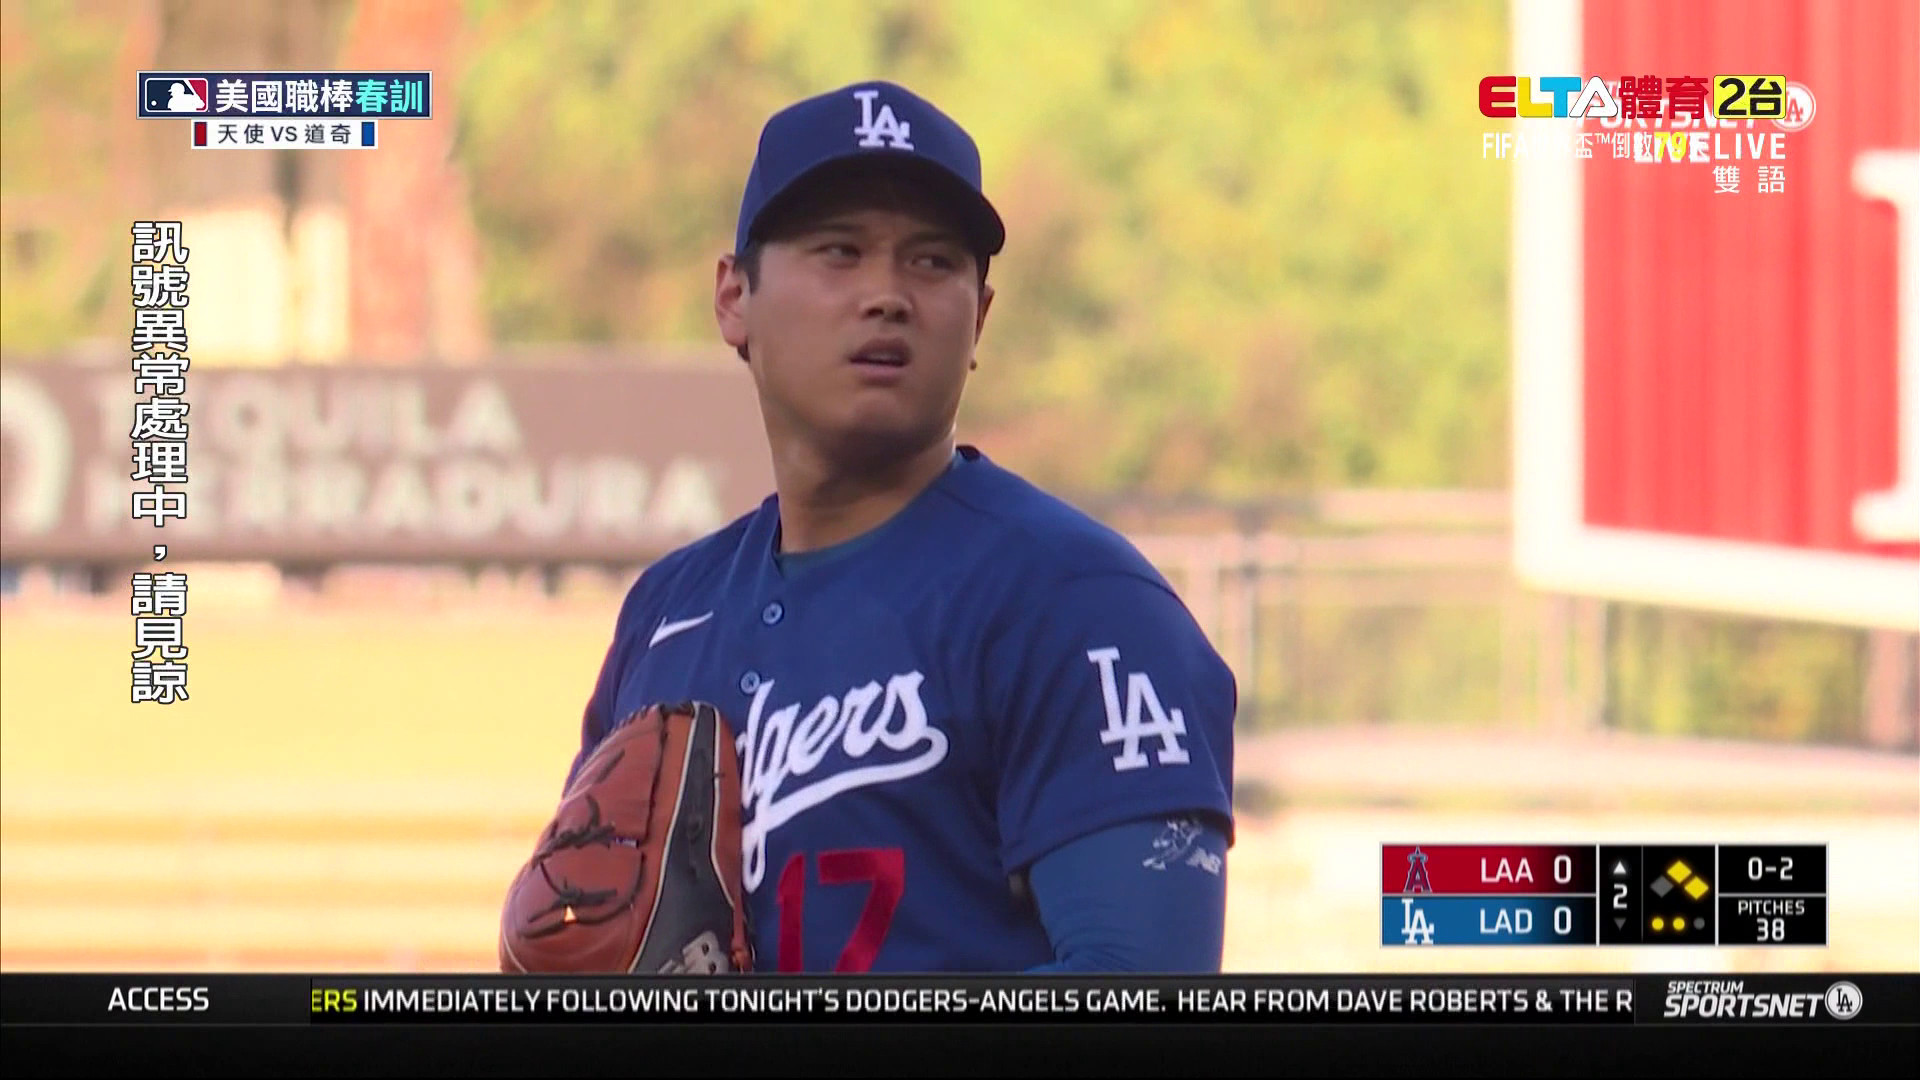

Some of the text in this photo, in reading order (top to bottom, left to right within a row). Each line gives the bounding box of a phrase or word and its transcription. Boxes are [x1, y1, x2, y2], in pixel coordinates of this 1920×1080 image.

[853, 90, 914, 150] LA
[86, 380, 522, 452] TQUILA
[84, 460, 722, 534] HRRADURA
[1087, 646, 1191, 772] LA
[736, 669, 949, 894] dgers
[776, 847, 905, 973] 17
